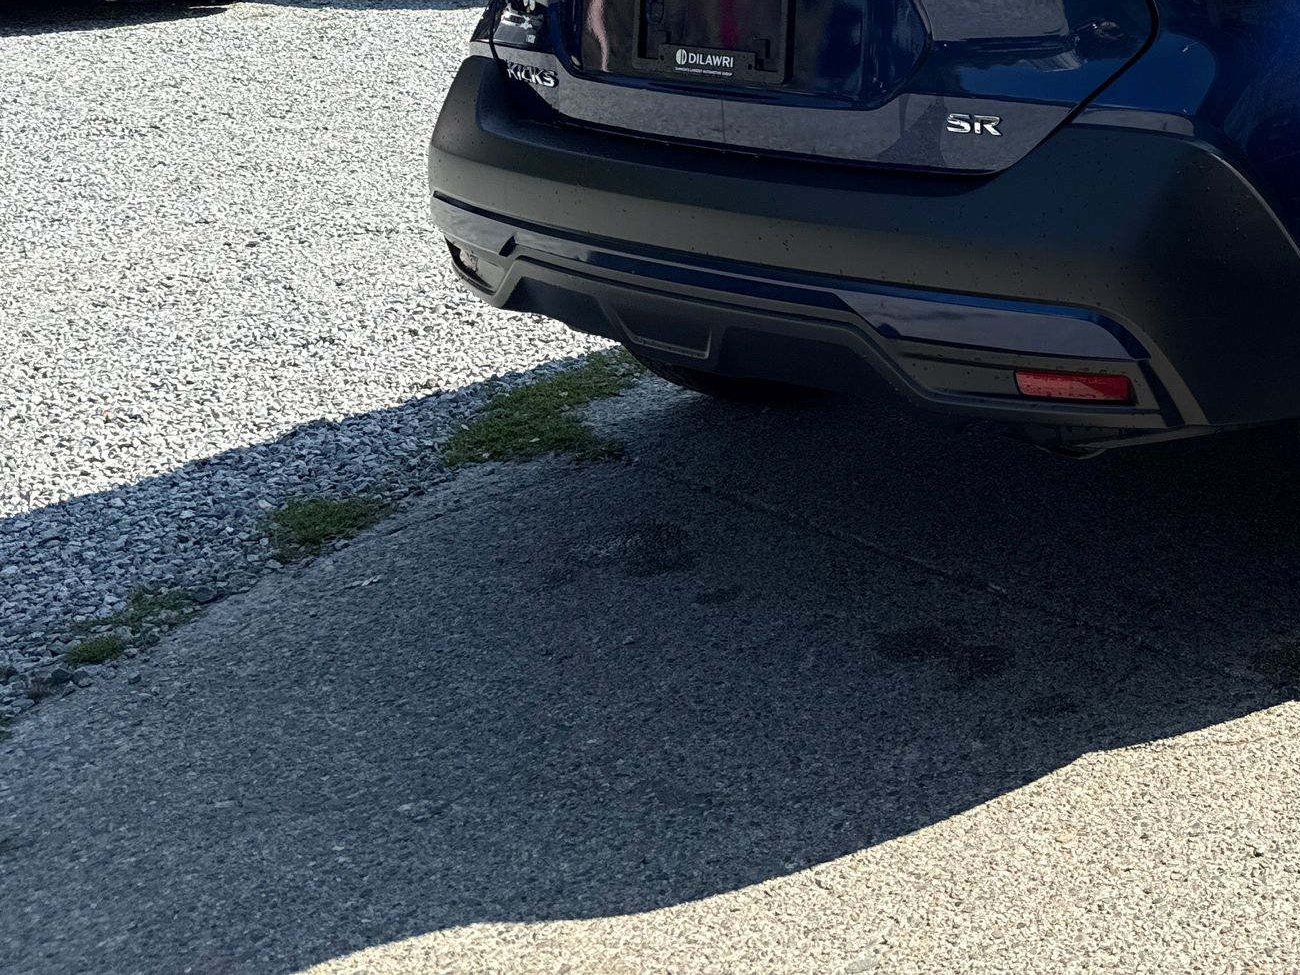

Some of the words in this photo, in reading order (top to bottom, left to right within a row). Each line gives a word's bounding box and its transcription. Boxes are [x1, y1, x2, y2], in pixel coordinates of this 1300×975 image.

[688, 52, 734, 68] DILAWRI
[506, 61, 556, 87] KICKS
[946, 113, 1002, 136] SR
